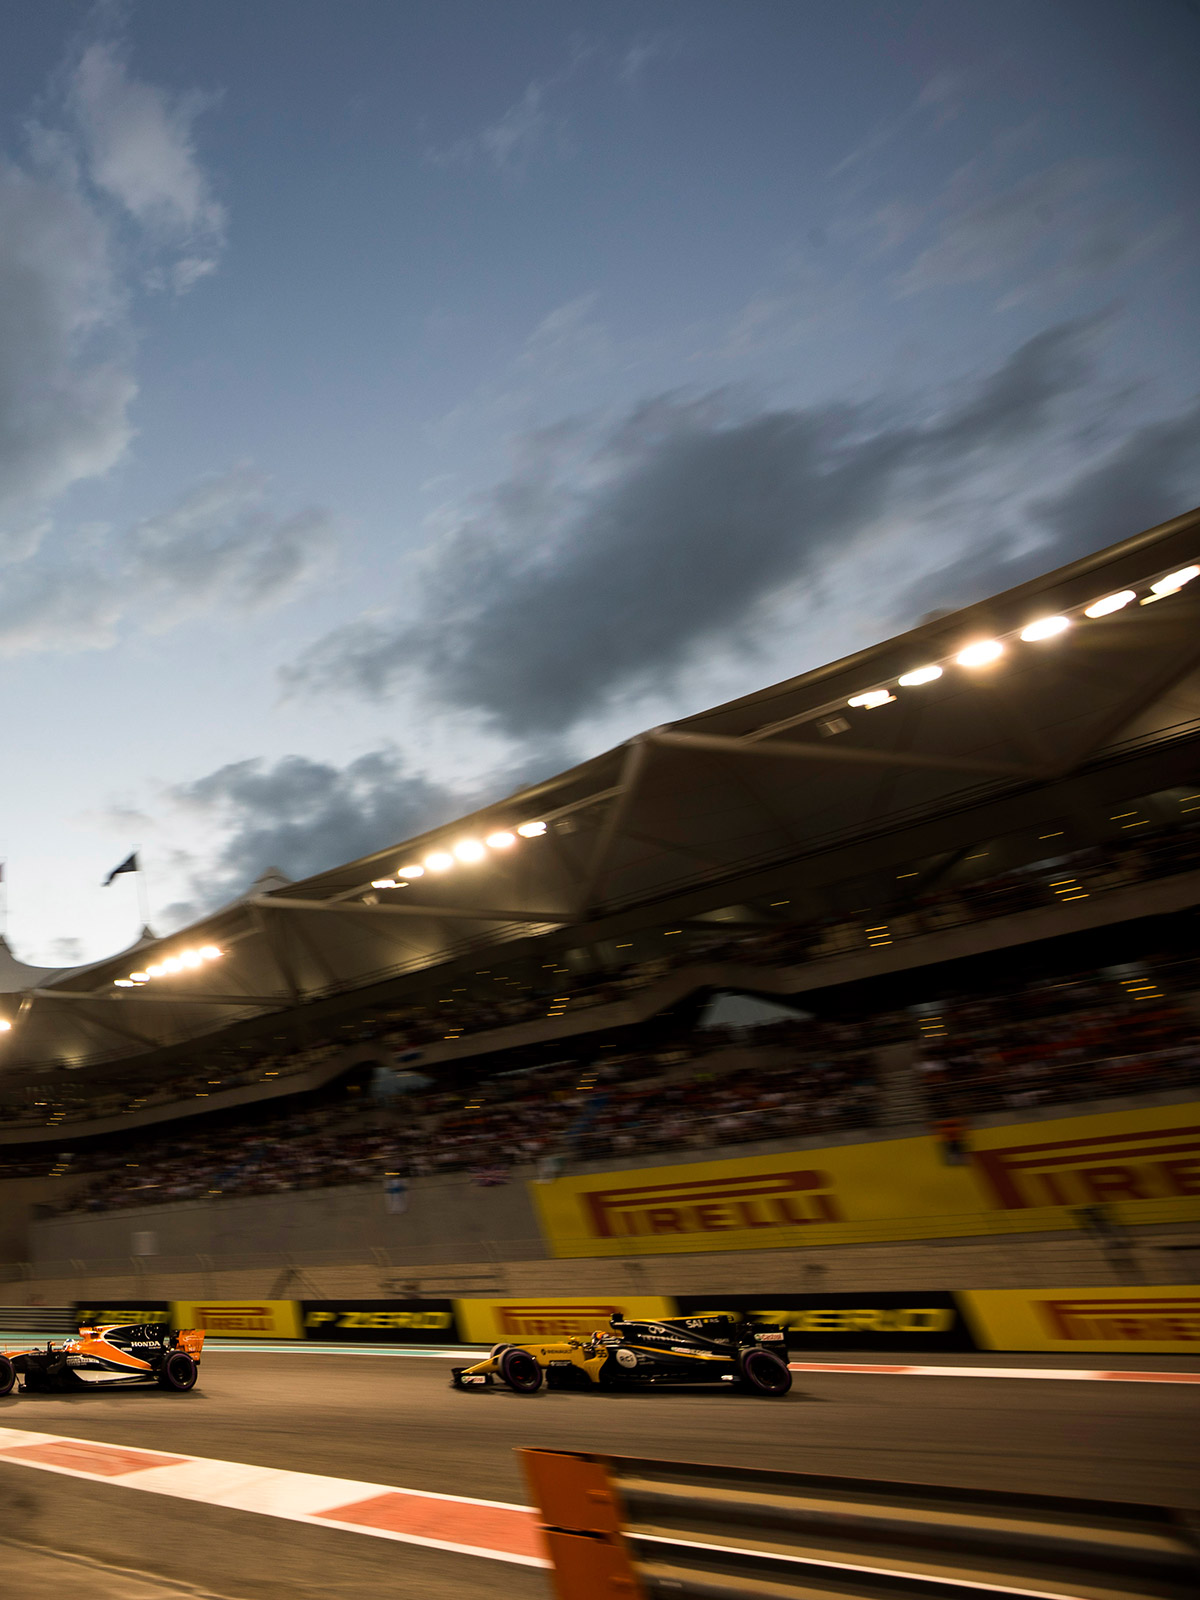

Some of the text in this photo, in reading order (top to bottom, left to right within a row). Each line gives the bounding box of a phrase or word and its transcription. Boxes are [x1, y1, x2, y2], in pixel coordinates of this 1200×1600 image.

[578, 1170, 844, 1238] PIRELLI
[304, 1312, 453, 1328] P ZERO
